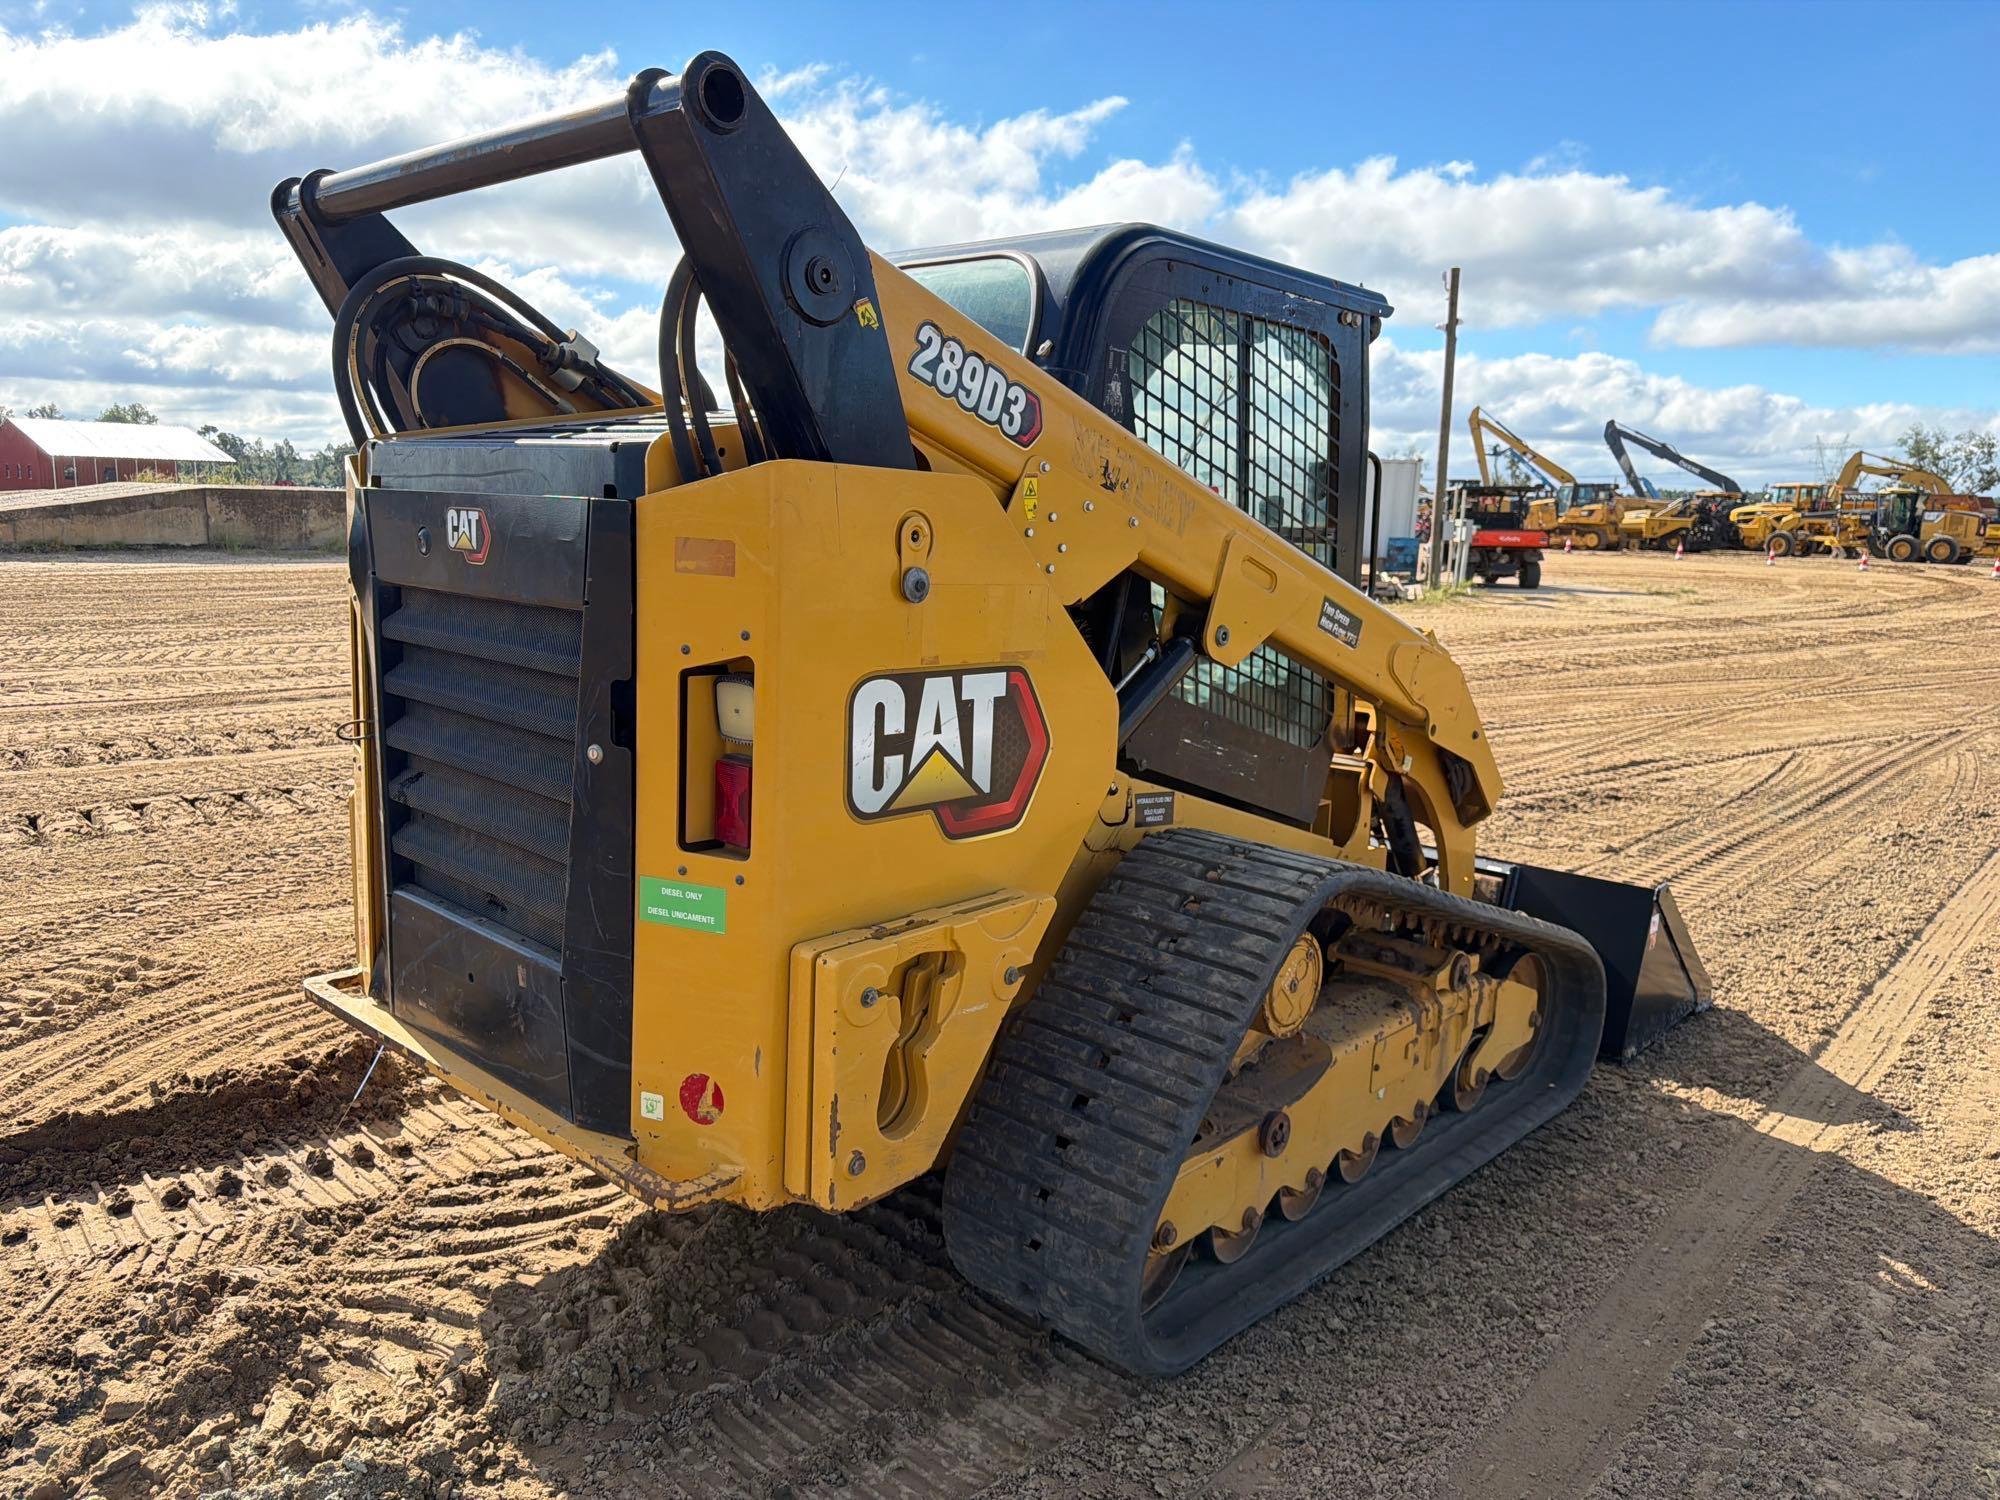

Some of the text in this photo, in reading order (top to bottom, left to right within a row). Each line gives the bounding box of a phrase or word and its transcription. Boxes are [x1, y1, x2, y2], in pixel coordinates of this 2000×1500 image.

[910, 324, 1027, 436] 289D3
[447, 508, 479, 550] CAT
[852, 671, 1007, 814] CAT
[661, 887, 703, 901] DIESEL ONLY
[647, 906, 716, 925] DIESEL UNICAMENTE
